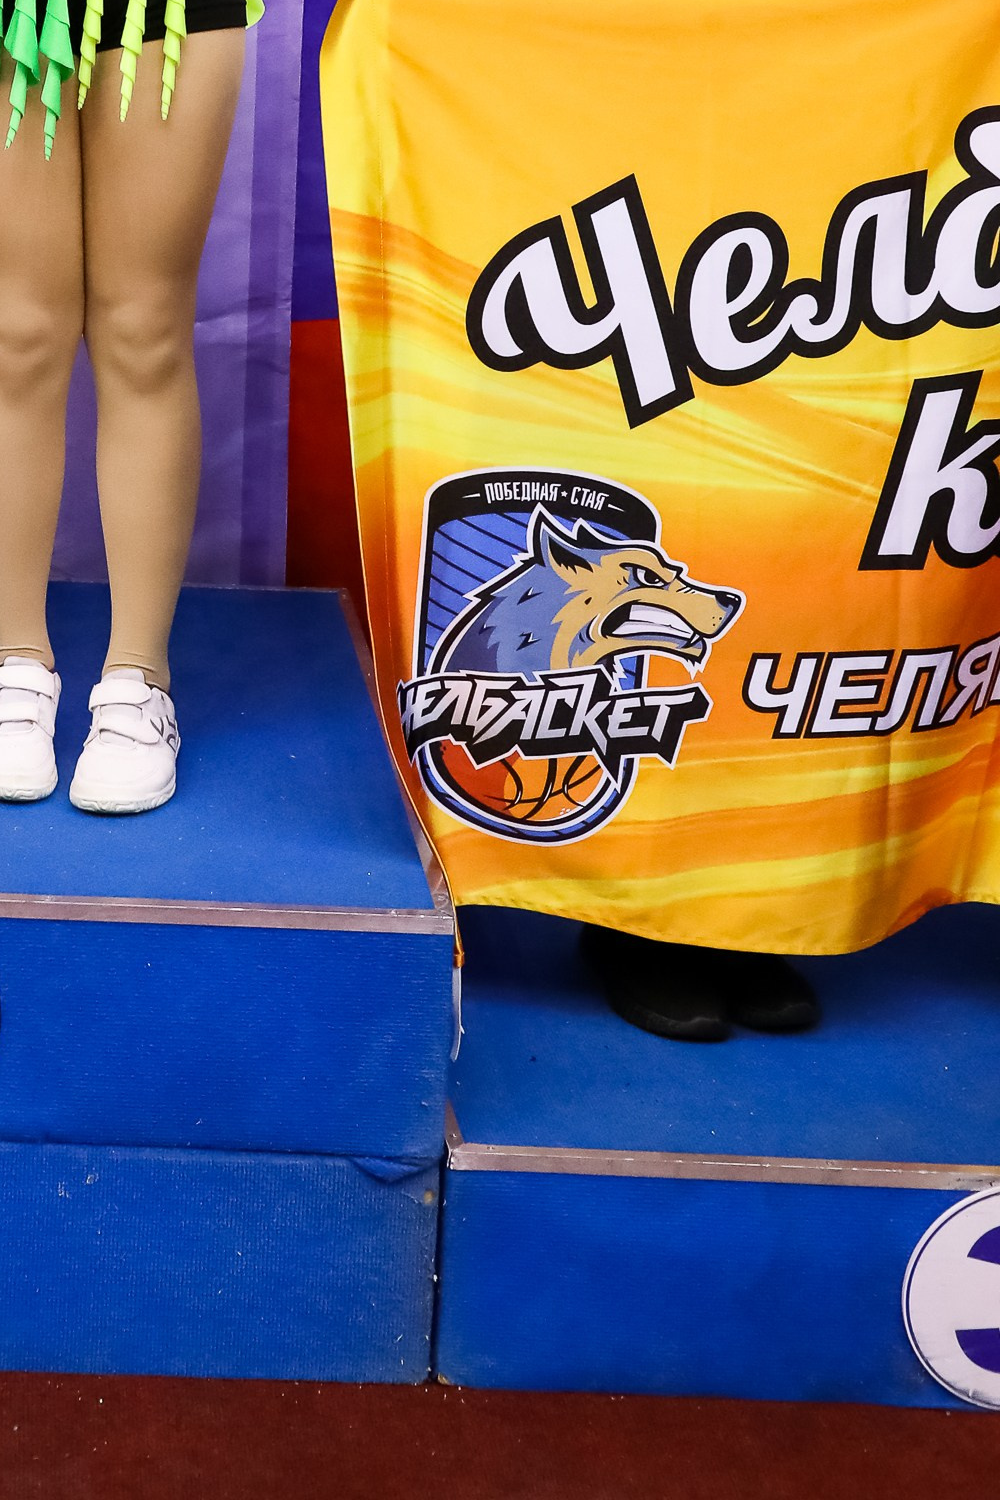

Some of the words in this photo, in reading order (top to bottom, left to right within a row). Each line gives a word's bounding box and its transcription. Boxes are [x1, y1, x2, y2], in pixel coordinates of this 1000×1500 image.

[484, 481, 562, 504] ПОБЕДНАЯ
[570, 486, 610, 511] СТАЯ
[744, 632, 1000, 738] ЧЕЛЯ
